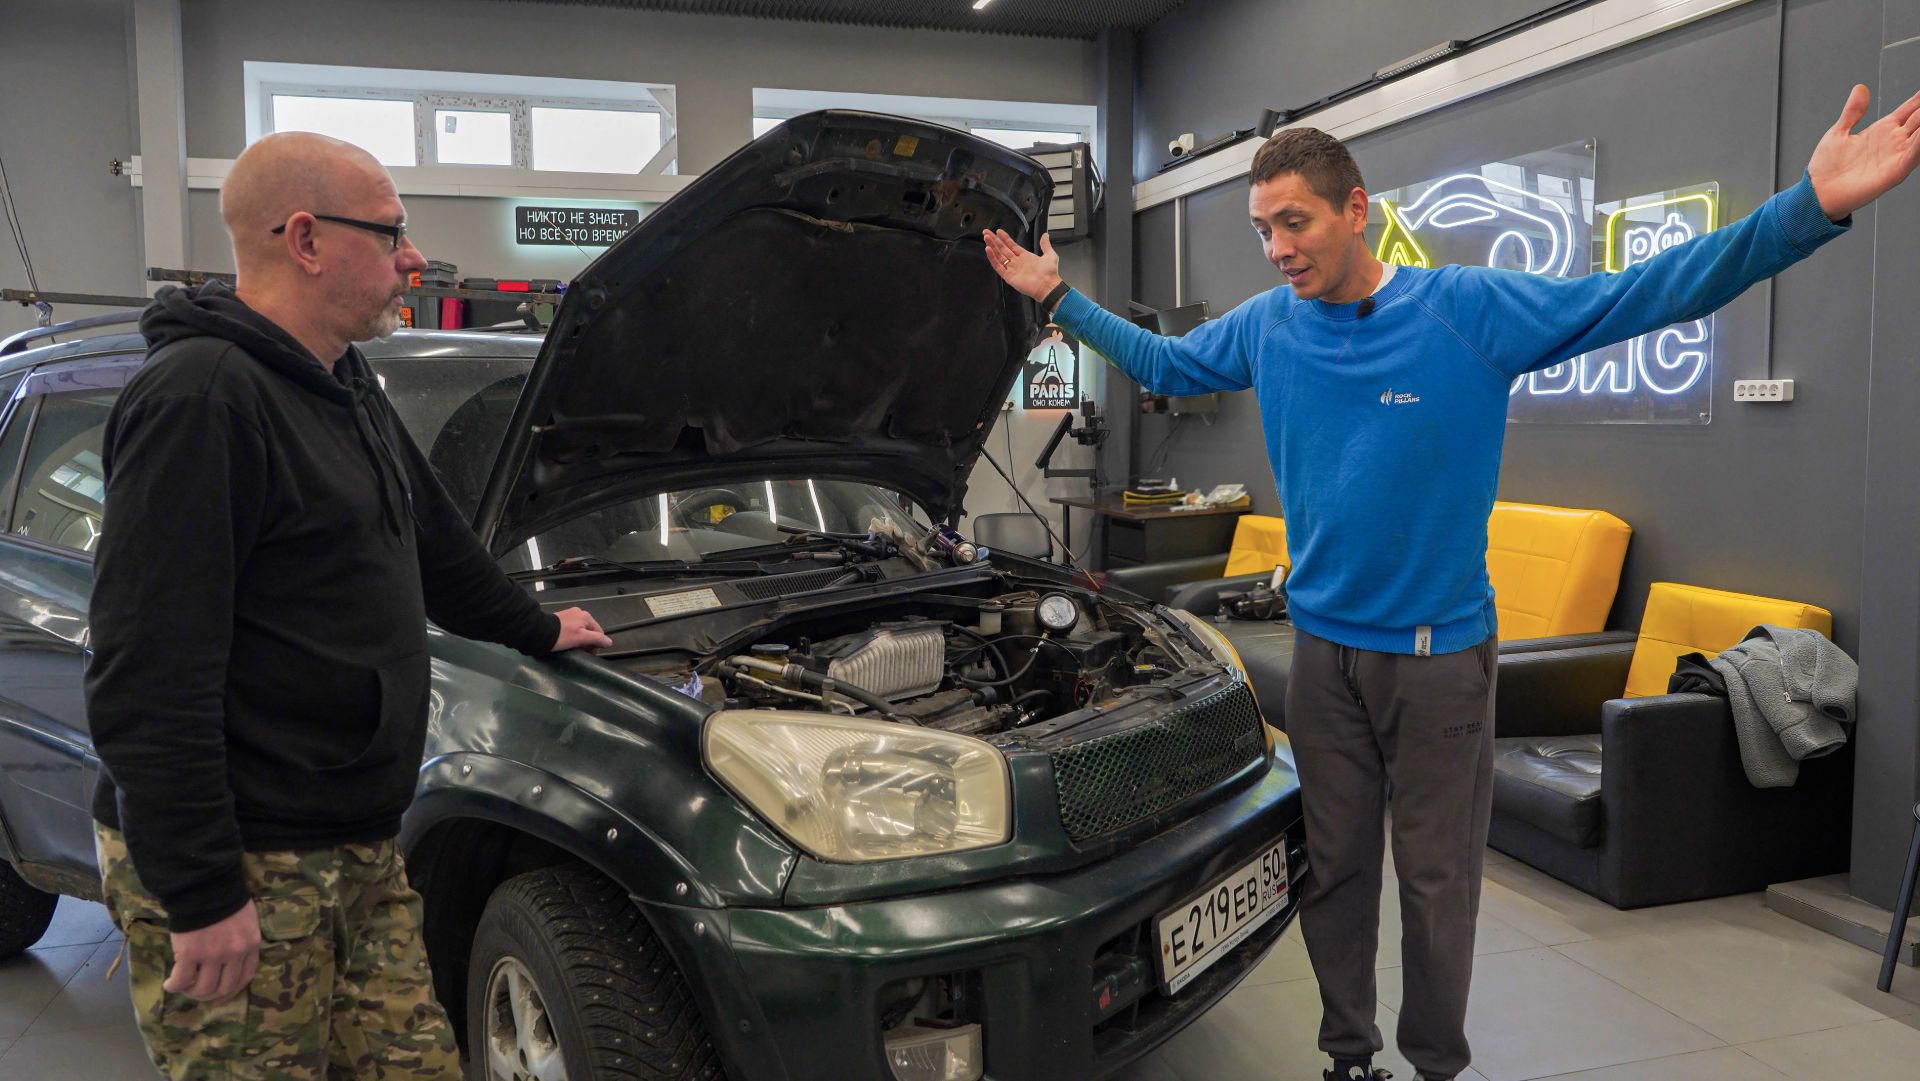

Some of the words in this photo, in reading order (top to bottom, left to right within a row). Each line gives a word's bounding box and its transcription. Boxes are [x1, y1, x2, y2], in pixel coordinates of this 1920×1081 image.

[527, 210, 566, 223] НИКТО
[570, 212, 585, 224] НЕ
[588, 212, 628, 226] ЗНАЕТ,
[519, 227, 536, 239] НО
[565, 229, 588, 241] ЭТО
[1029, 384, 1075, 399] PARIS
[1394, 396, 1420, 404] PILLARS
[1262, 847, 1281, 887] 50
[1262, 884, 1277, 902] RUS
